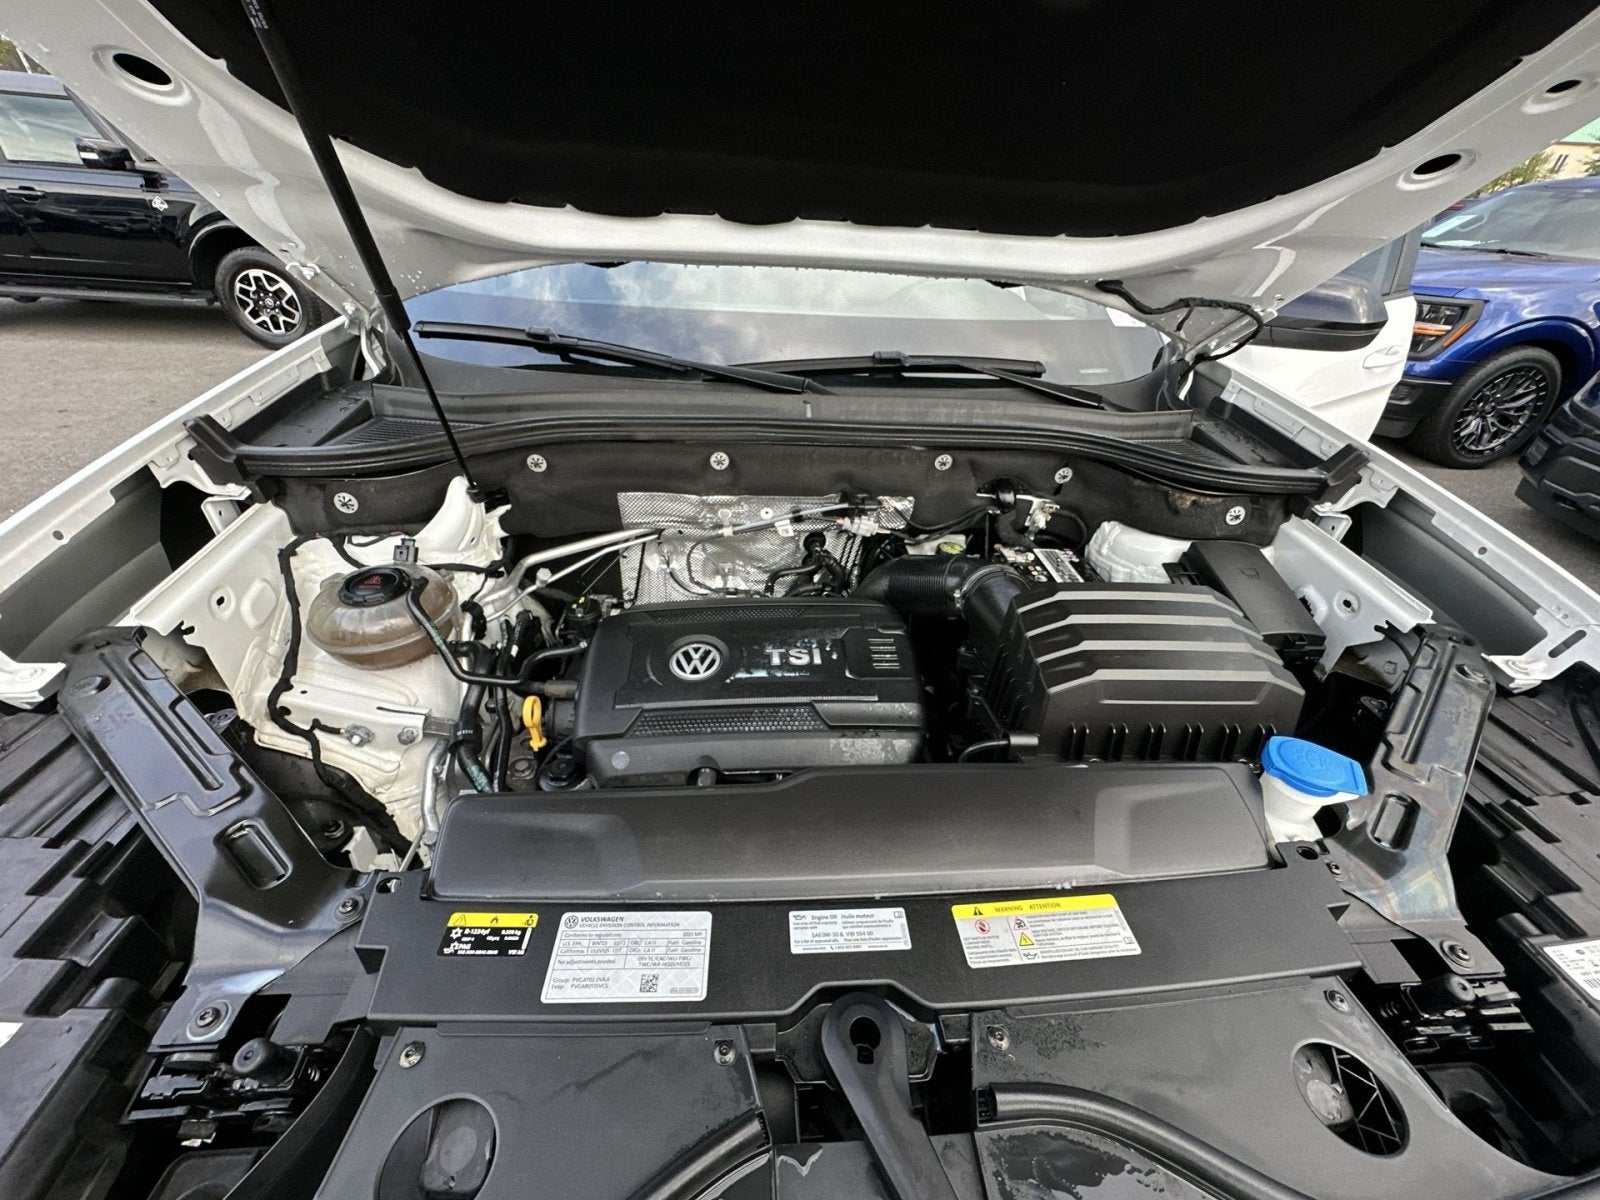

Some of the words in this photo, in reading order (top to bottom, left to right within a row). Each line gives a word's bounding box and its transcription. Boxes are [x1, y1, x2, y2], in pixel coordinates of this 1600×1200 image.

[764, 648, 822, 666] TSI
[994, 905, 1023, 913] WARNING
[1029, 902, 1061, 910] ATTENTION
